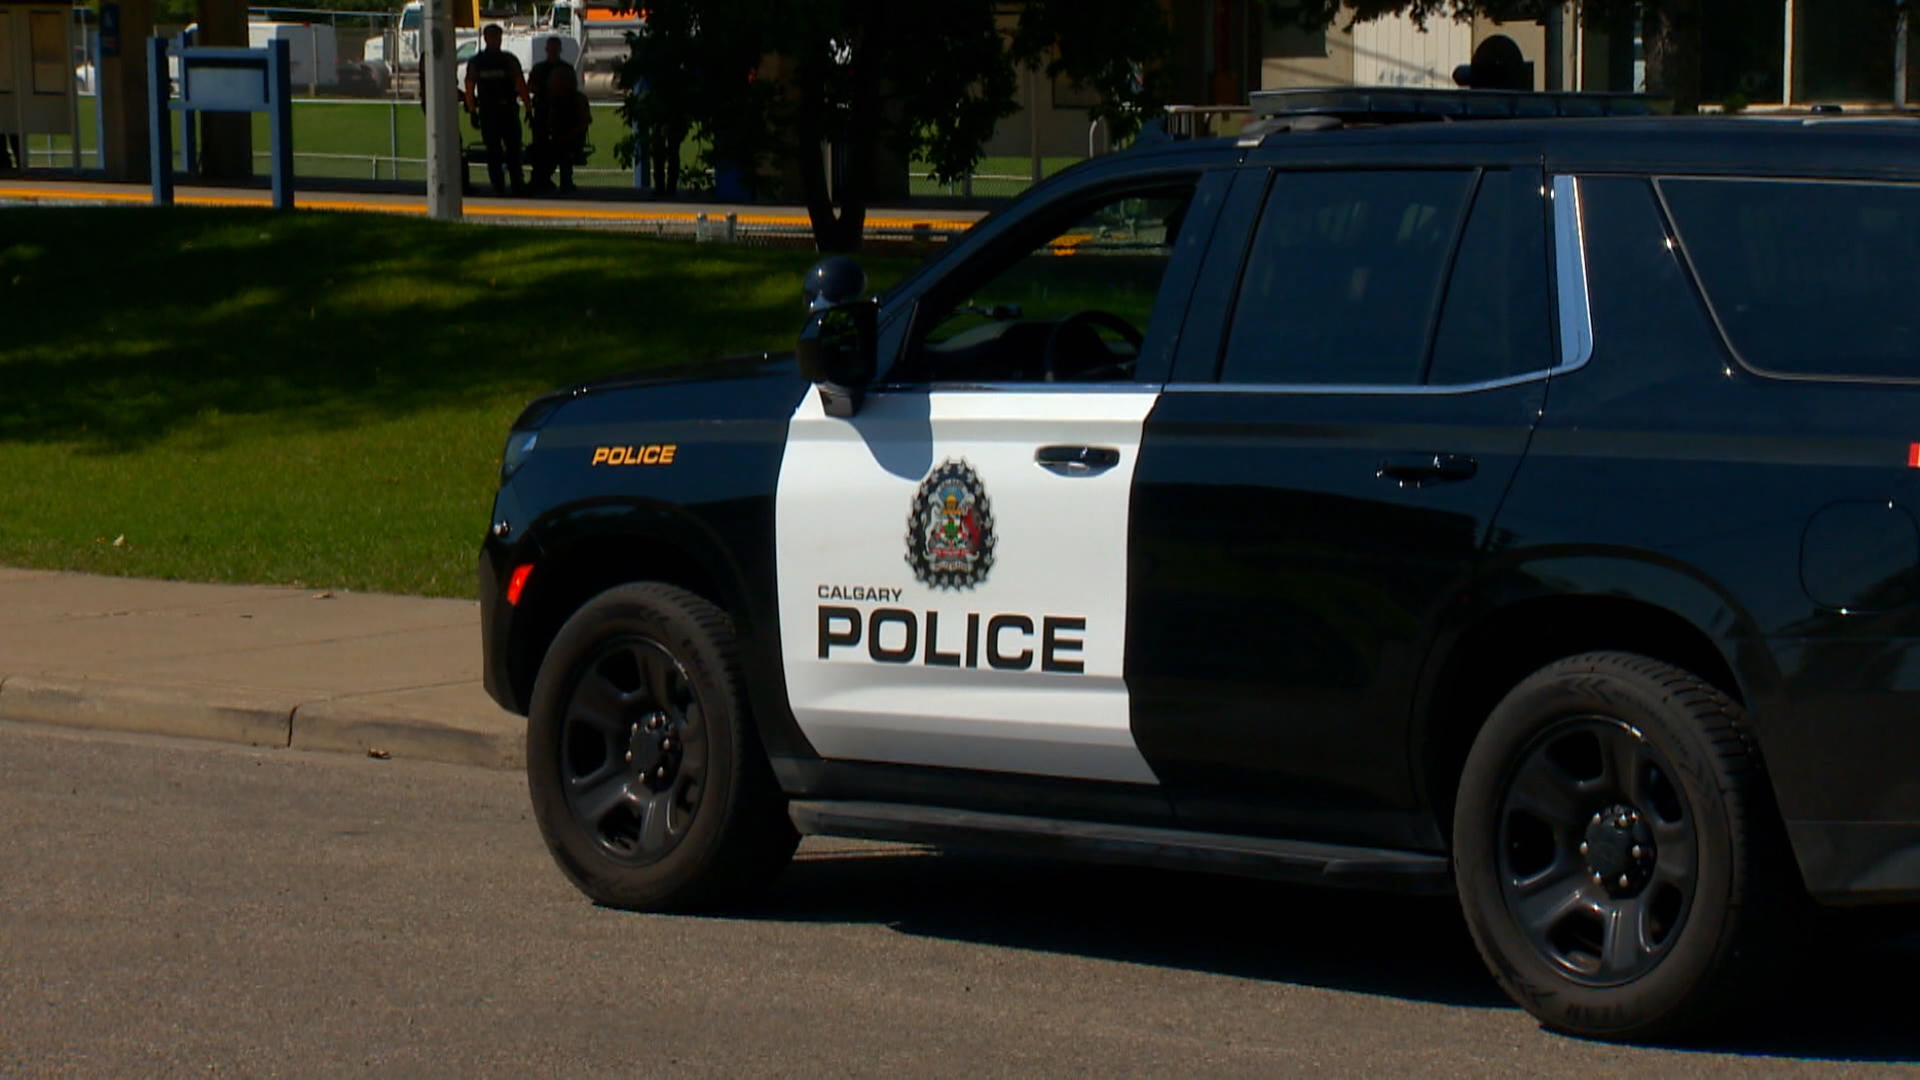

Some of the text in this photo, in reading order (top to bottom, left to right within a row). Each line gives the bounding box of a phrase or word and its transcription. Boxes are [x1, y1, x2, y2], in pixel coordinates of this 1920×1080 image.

[592, 444, 677, 467] POLICE
[817, 584, 903, 602] CALGARY
[818, 604, 1086, 674] POLICE
